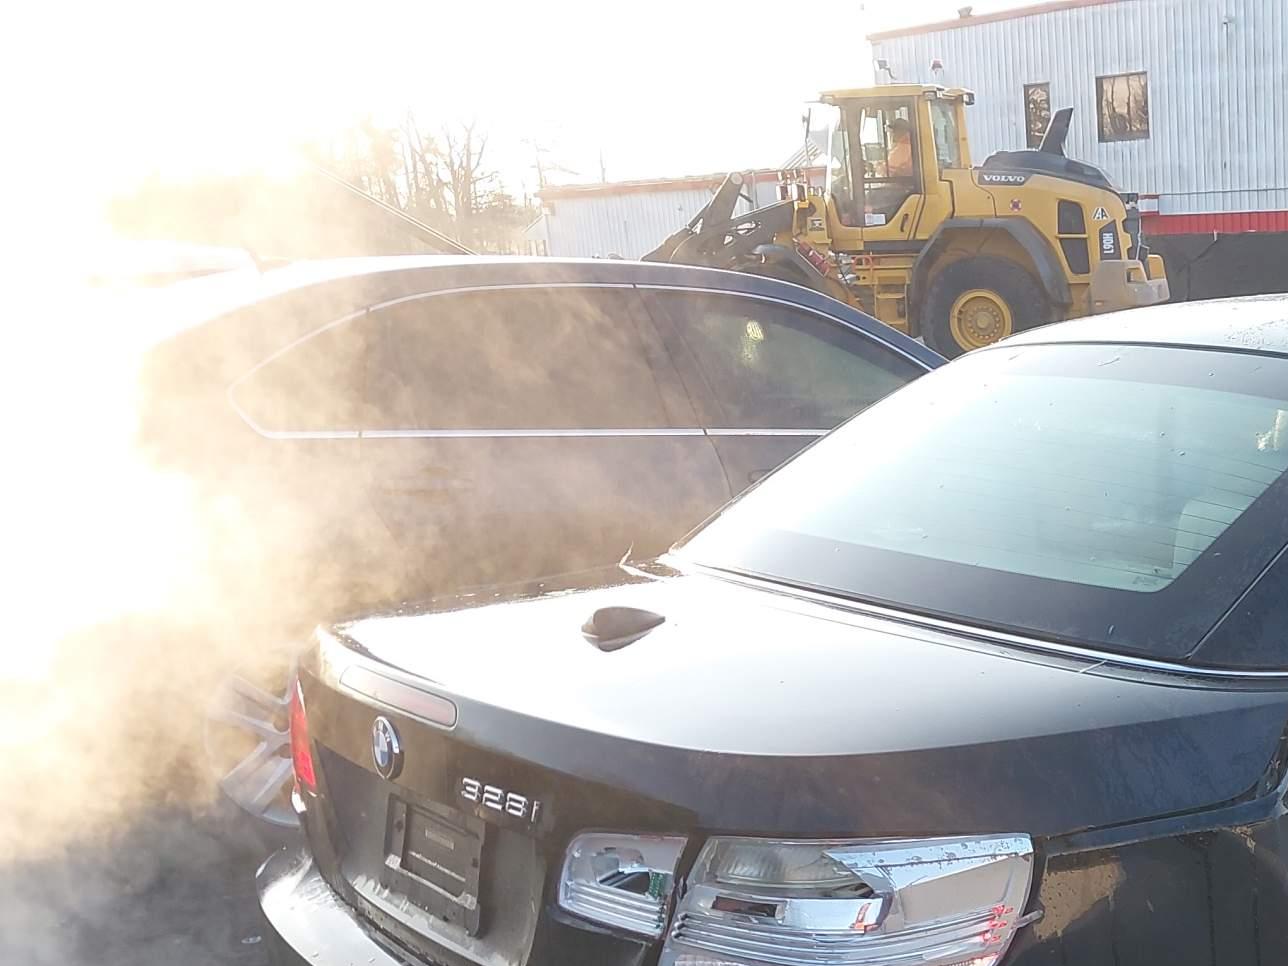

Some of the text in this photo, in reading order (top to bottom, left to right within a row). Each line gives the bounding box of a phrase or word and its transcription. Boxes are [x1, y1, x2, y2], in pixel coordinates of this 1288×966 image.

[983, 174, 1025, 182] VOLVO
[1102, 232, 1114, 254] L90H
[460, 777, 541, 823] 328i
